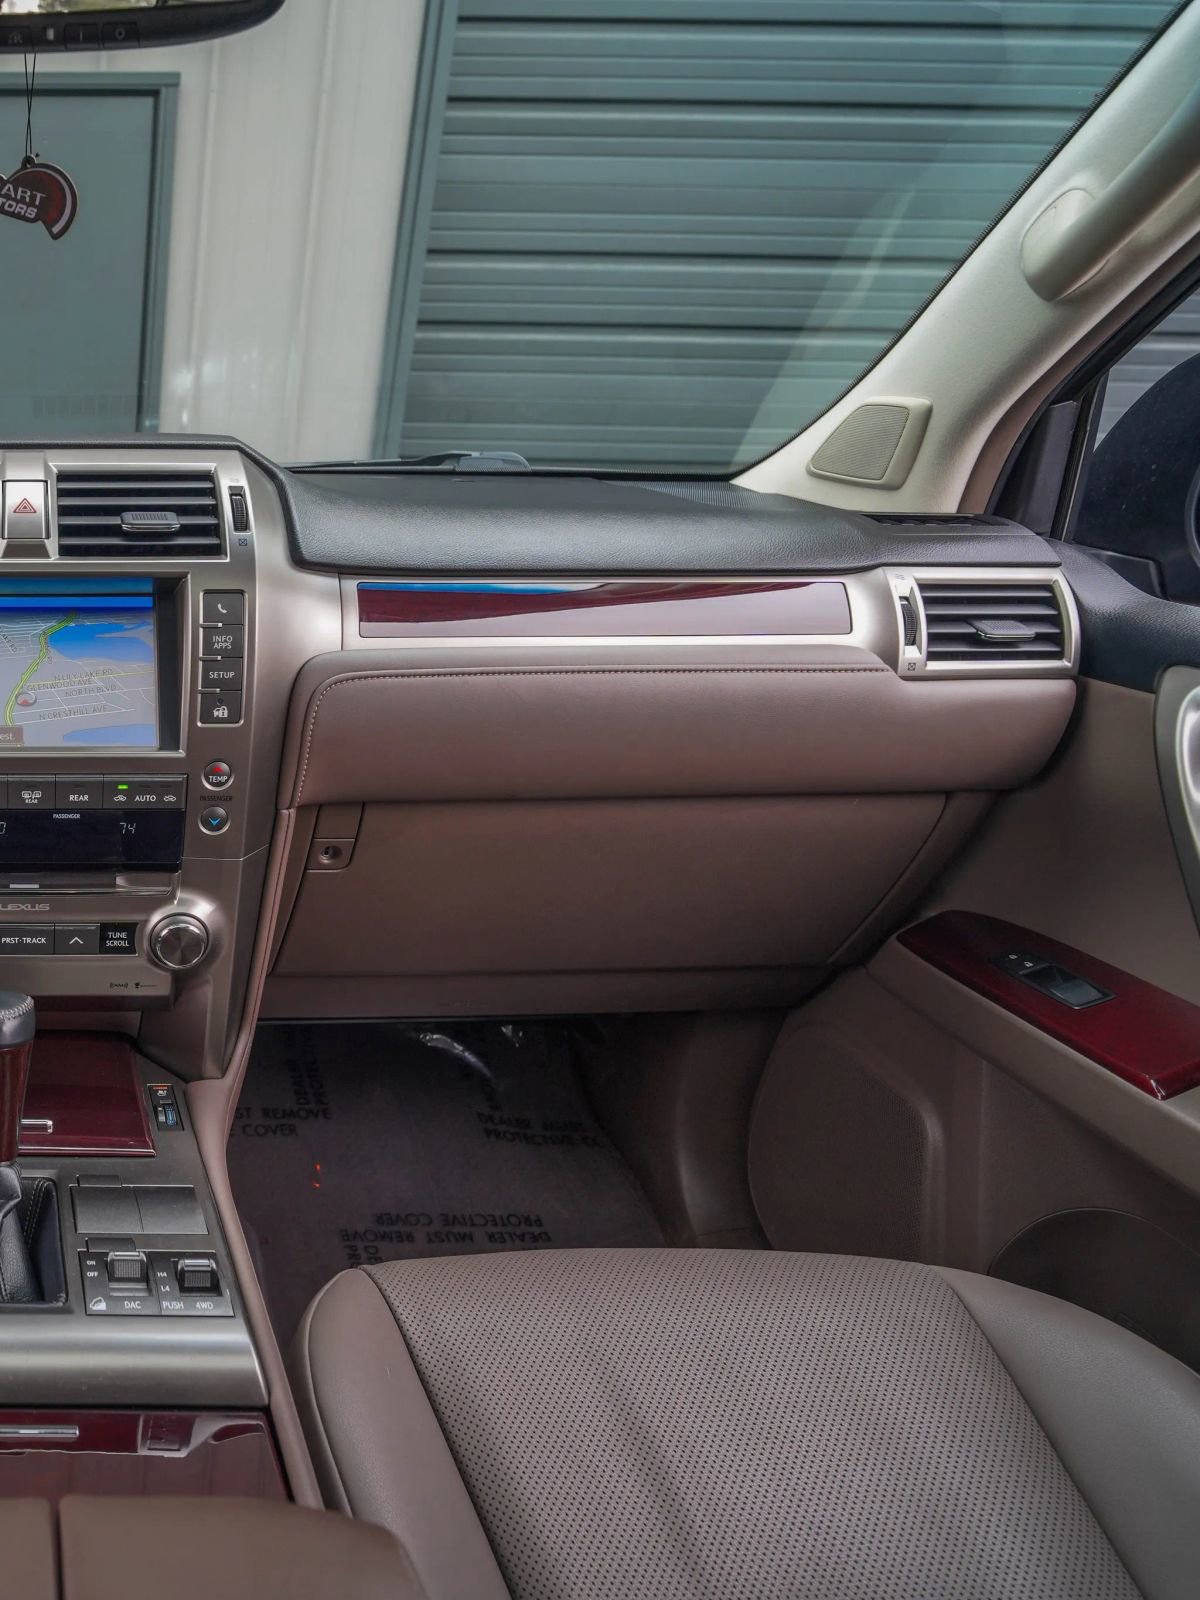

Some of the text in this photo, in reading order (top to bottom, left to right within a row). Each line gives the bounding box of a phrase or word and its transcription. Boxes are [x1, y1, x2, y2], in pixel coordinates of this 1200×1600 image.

[212, 635, 233, 643] INFO
[209, 671, 235, 679] SETUP
[65, 688, 94, 697] NORTH
[208, 775, 228, 783] TEMP
[69, 794, 89, 802] REAR
[119, 822, 137, 834] 74
[107, 931, 128, 939] TUNE
[105, 939, 130, 947] SCROLL
[261, 1106, 332, 1121] REMOVE
[241, 1123, 298, 1137] COVER
[375, 1213, 544, 1227] PROTECTIVE COVER
[340, 1229, 552, 1244] DEALER MUST REMOVE
[124, 1301, 141, 1309] DAC
[162, 1301, 214, 1310] PUSH 4WD
